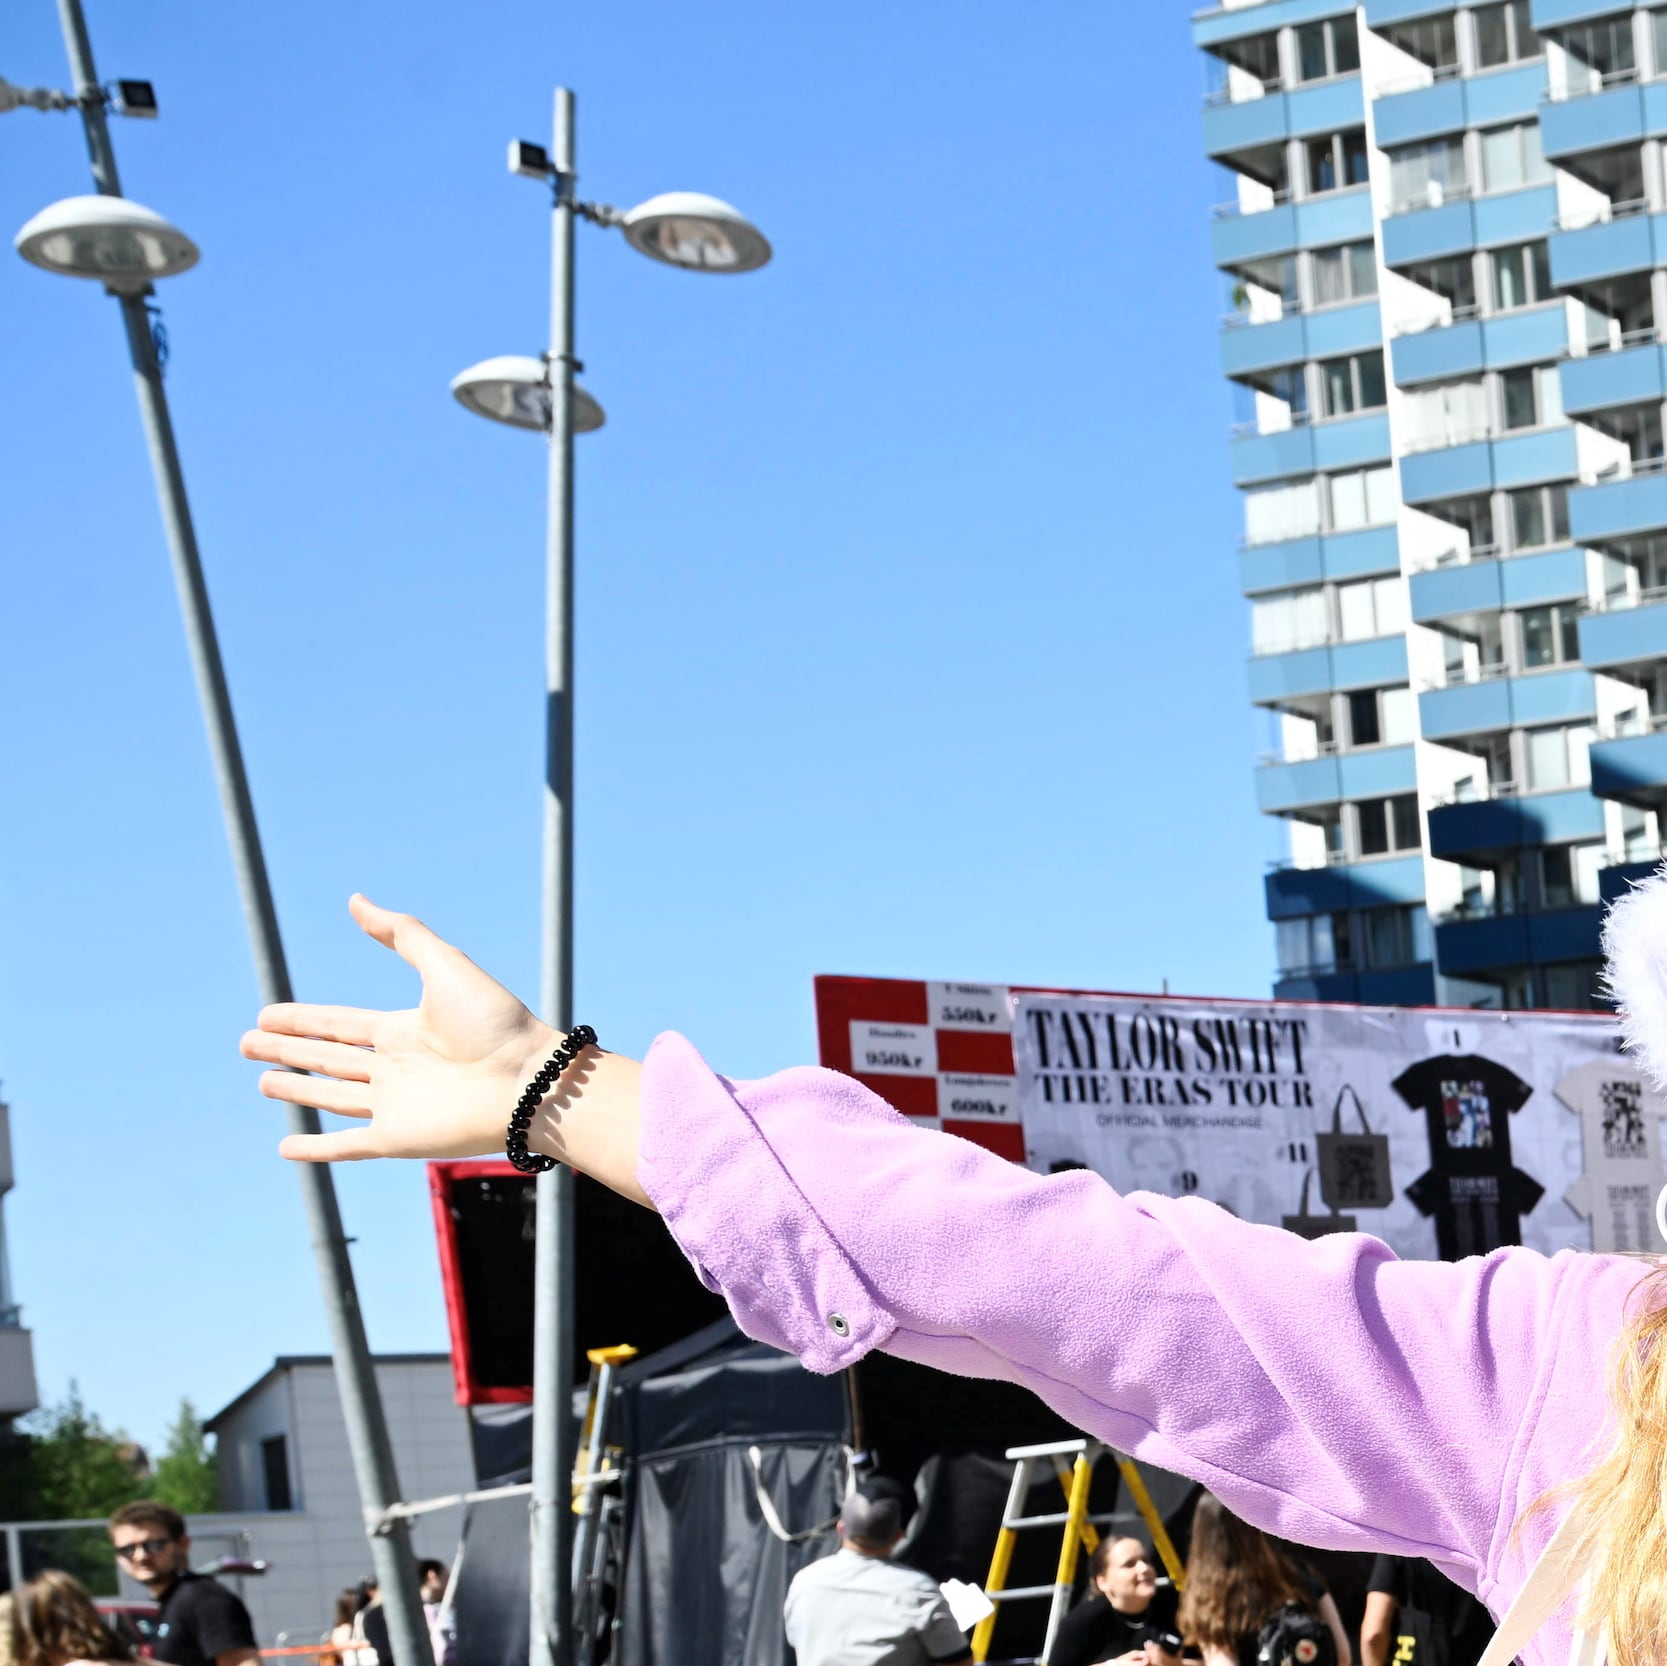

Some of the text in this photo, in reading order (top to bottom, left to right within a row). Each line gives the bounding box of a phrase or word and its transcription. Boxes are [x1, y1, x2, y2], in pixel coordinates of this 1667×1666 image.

[942, 1005, 997, 1023] 550kr
[1027, 1009, 1306, 1074] TAYLOR SWIFT
[866, 1050, 922, 1068] 950kr
[1034, 1073, 1313, 1108] THE ERAS TOUR
[951, 1098, 1007, 1115] 600kr
